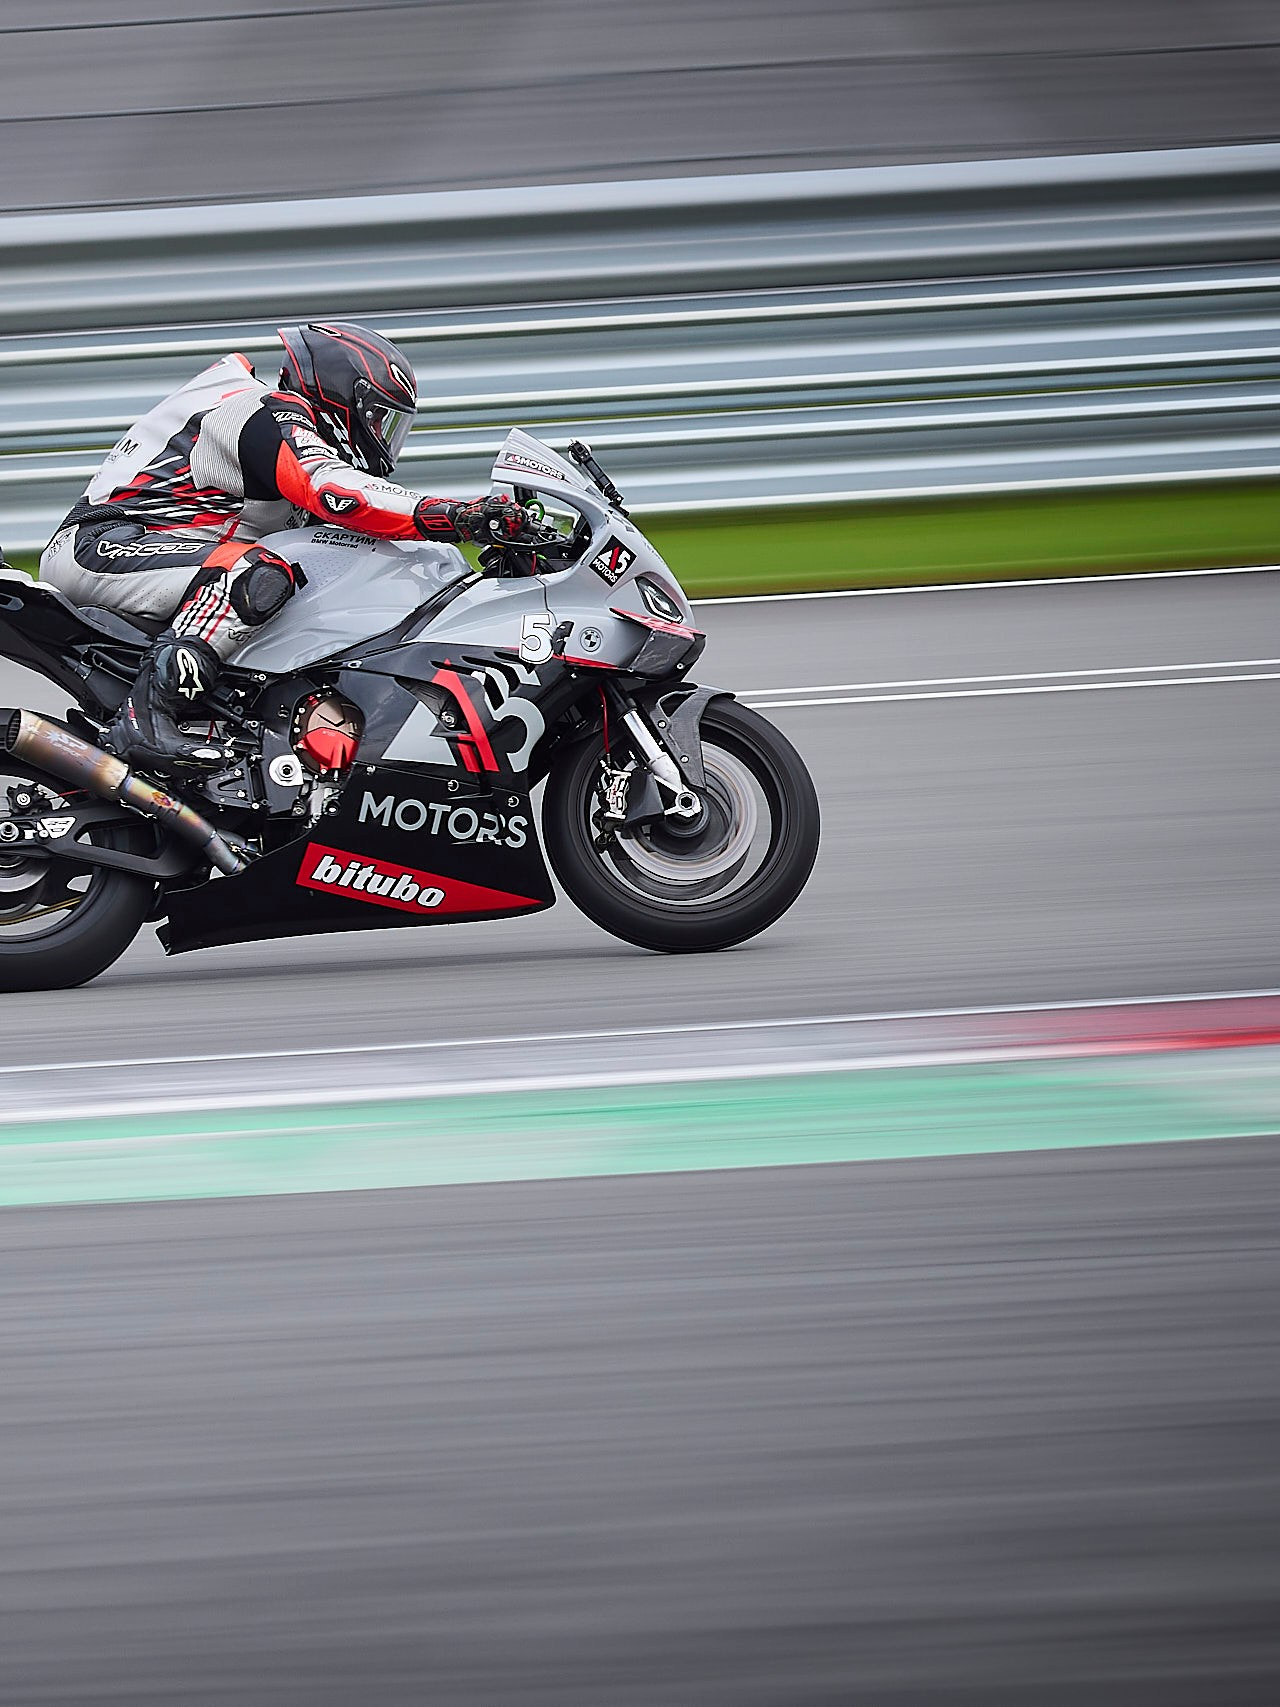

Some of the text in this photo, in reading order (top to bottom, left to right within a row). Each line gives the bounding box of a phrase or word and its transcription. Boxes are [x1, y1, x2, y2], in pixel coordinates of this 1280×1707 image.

[520, 458, 563, 480] MOTORS
[313, 531, 376, 546] СКАРТИМ
[328, 540, 359, 549] Motorrad
[592, 558, 618, 583] MOTORS
[358, 791, 529, 849] MOTORS
[311, 855, 446, 908] bitubo
